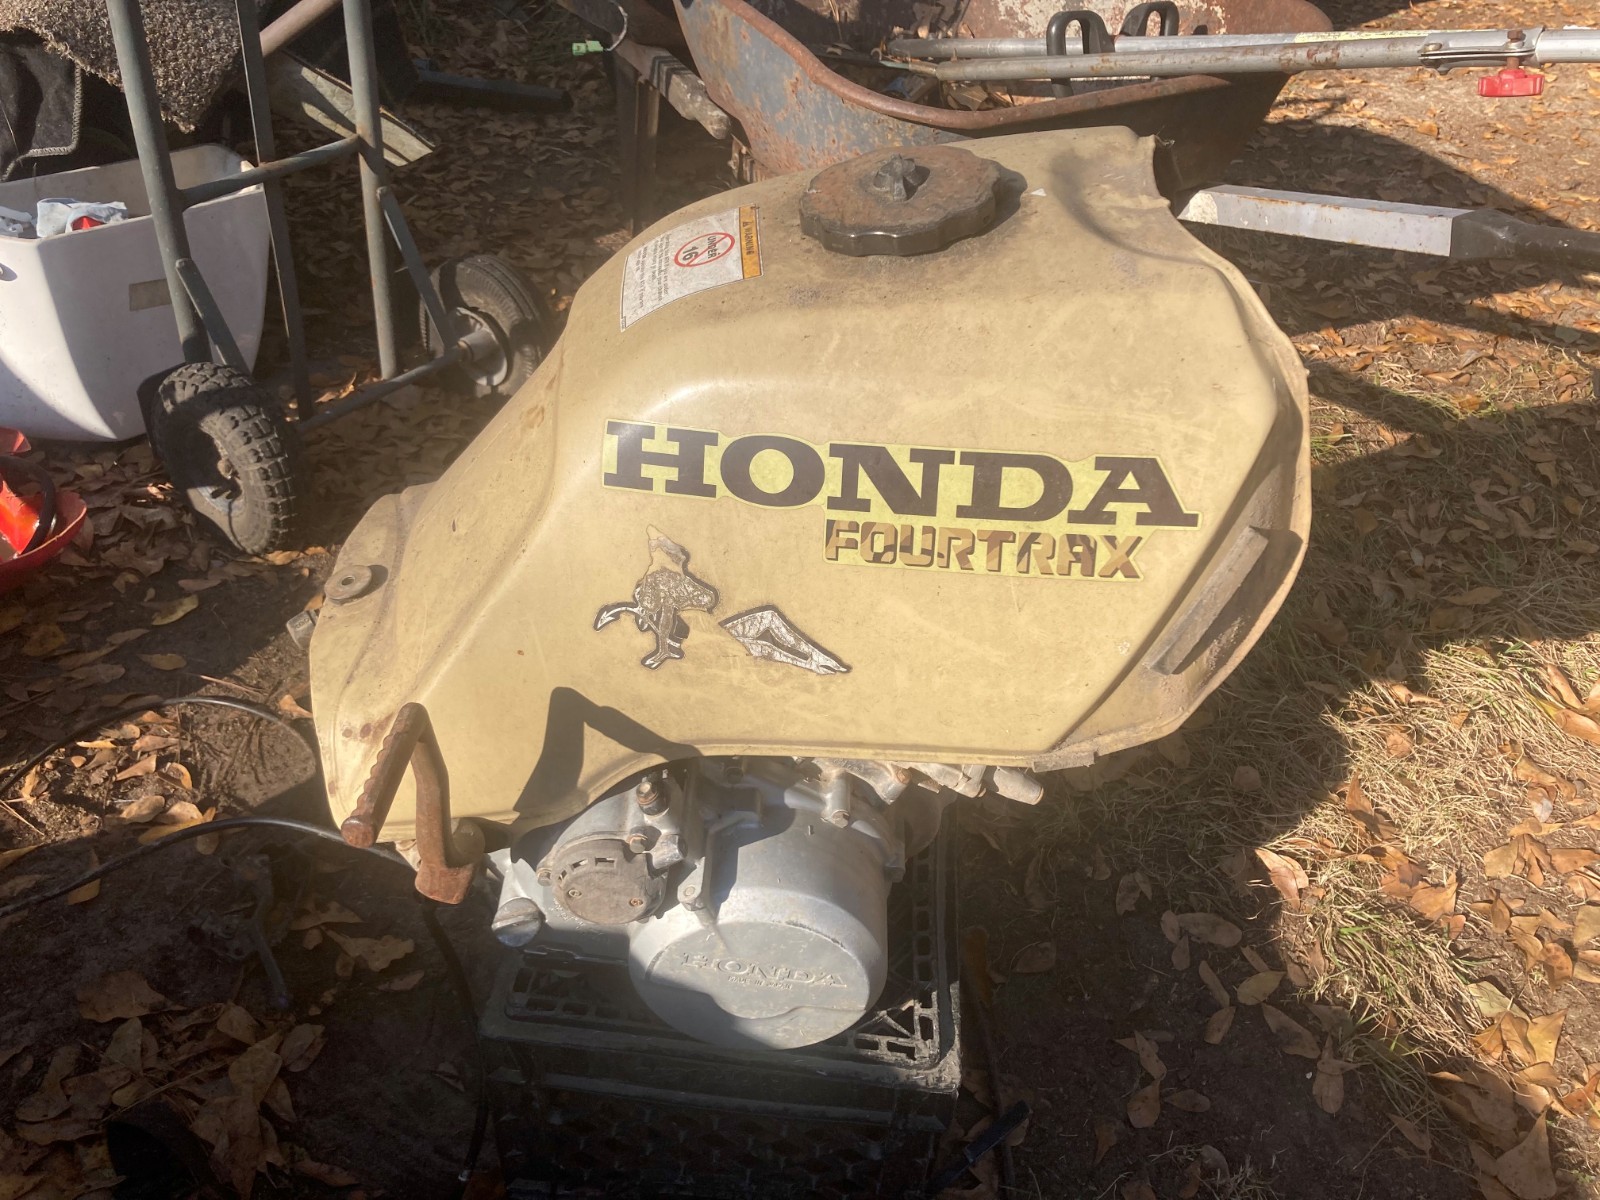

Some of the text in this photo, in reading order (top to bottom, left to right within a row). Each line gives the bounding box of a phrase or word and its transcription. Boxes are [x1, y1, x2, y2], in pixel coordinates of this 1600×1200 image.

[682, 246, 699, 261] 16
[707, 235, 719, 259] UNDER
[744, 227, 755, 256] WARNING
[603, 420, 1200, 528] HONDA
[825, 519, 1142, 578] FOURTRAX
[681, 952, 848, 988] HONDA
[728, 975, 751, 985] MADE
